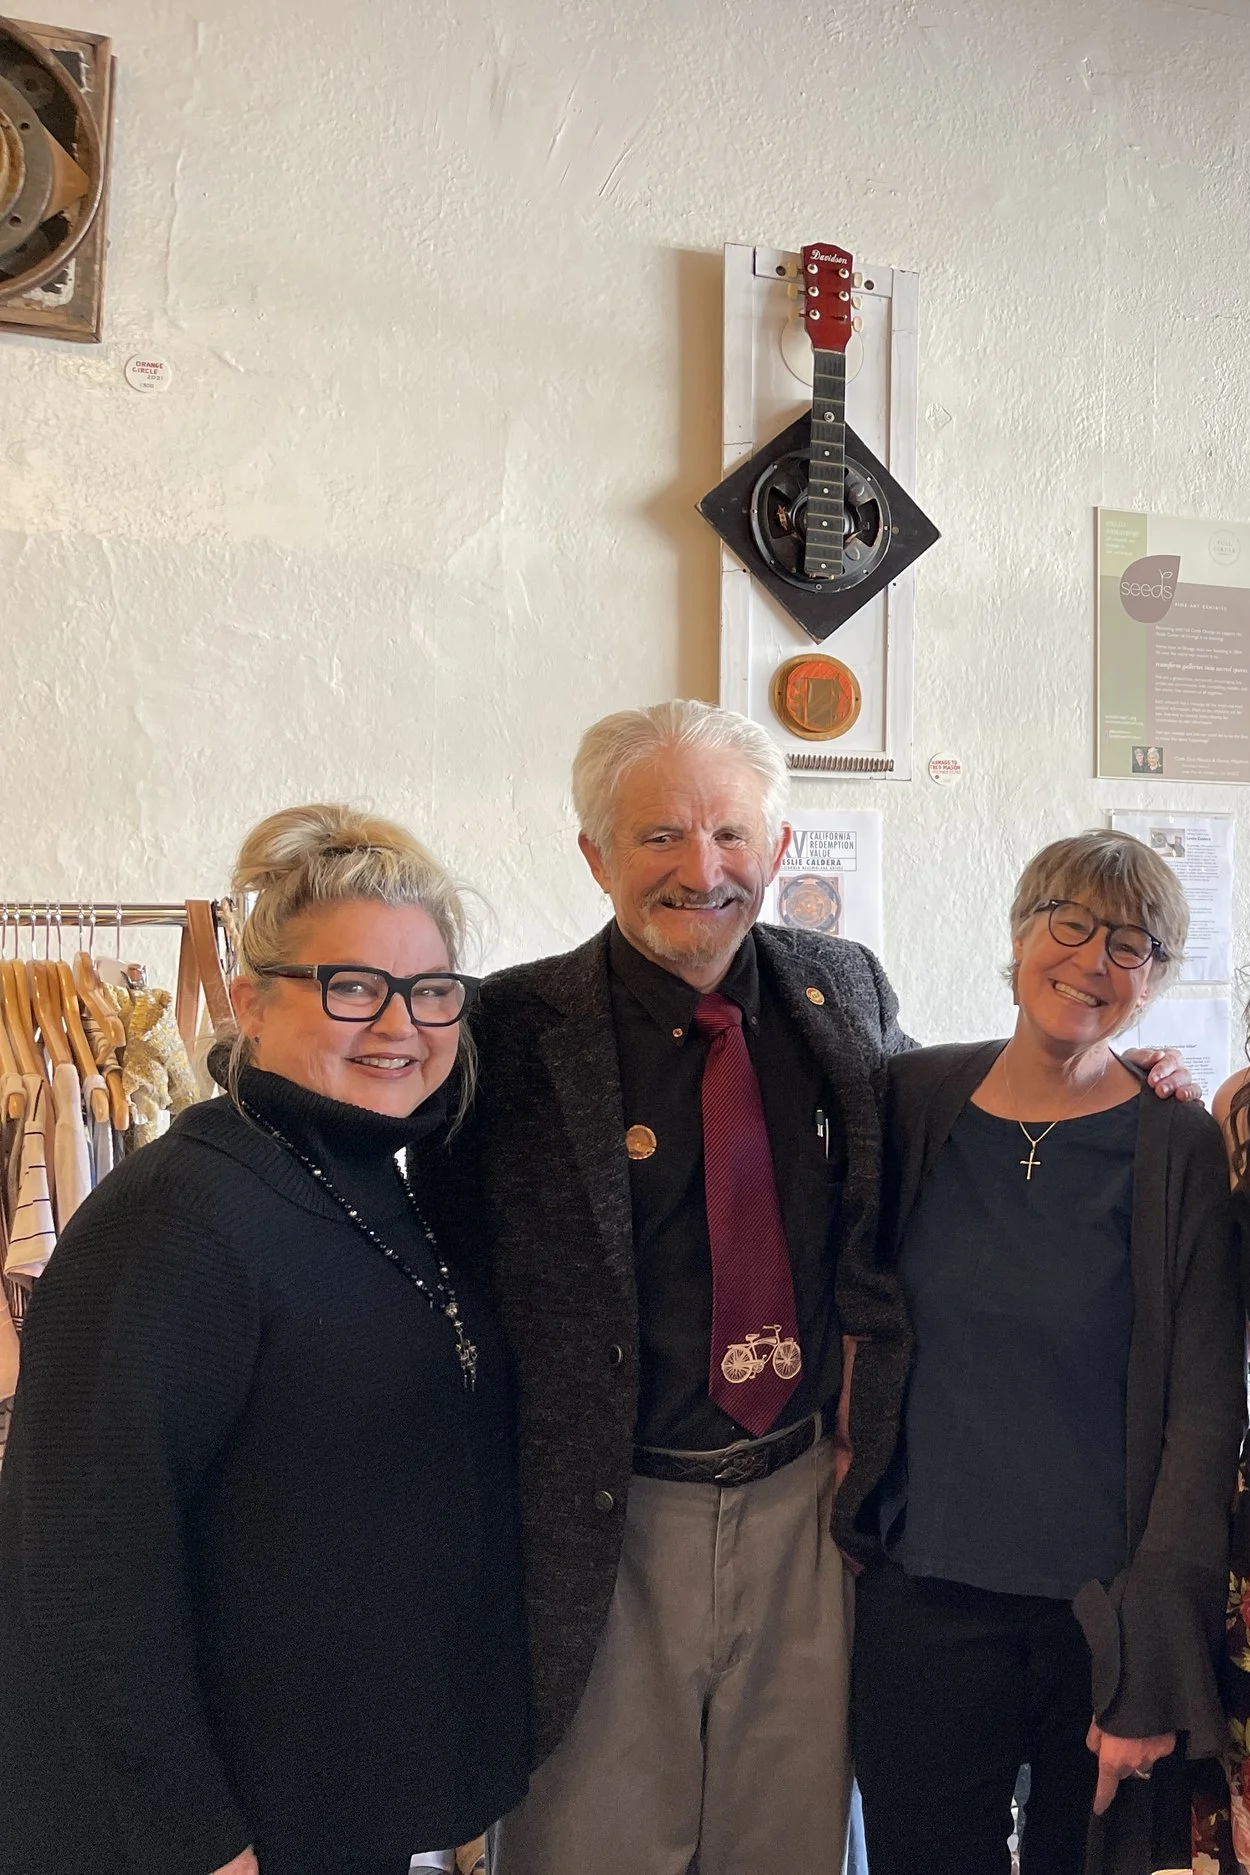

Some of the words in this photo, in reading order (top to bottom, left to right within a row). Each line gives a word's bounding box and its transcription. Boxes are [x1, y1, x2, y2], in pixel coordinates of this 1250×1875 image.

[810, 249, 848, 264] Davidson
[136, 361, 164, 369] ORANGE
[1120, 569, 1173, 601] seeds
[809, 832, 851, 841] CALIFORNIA
[809, 841, 854, 849] REDEMPTION
[809, 849, 831, 858] VALUE
